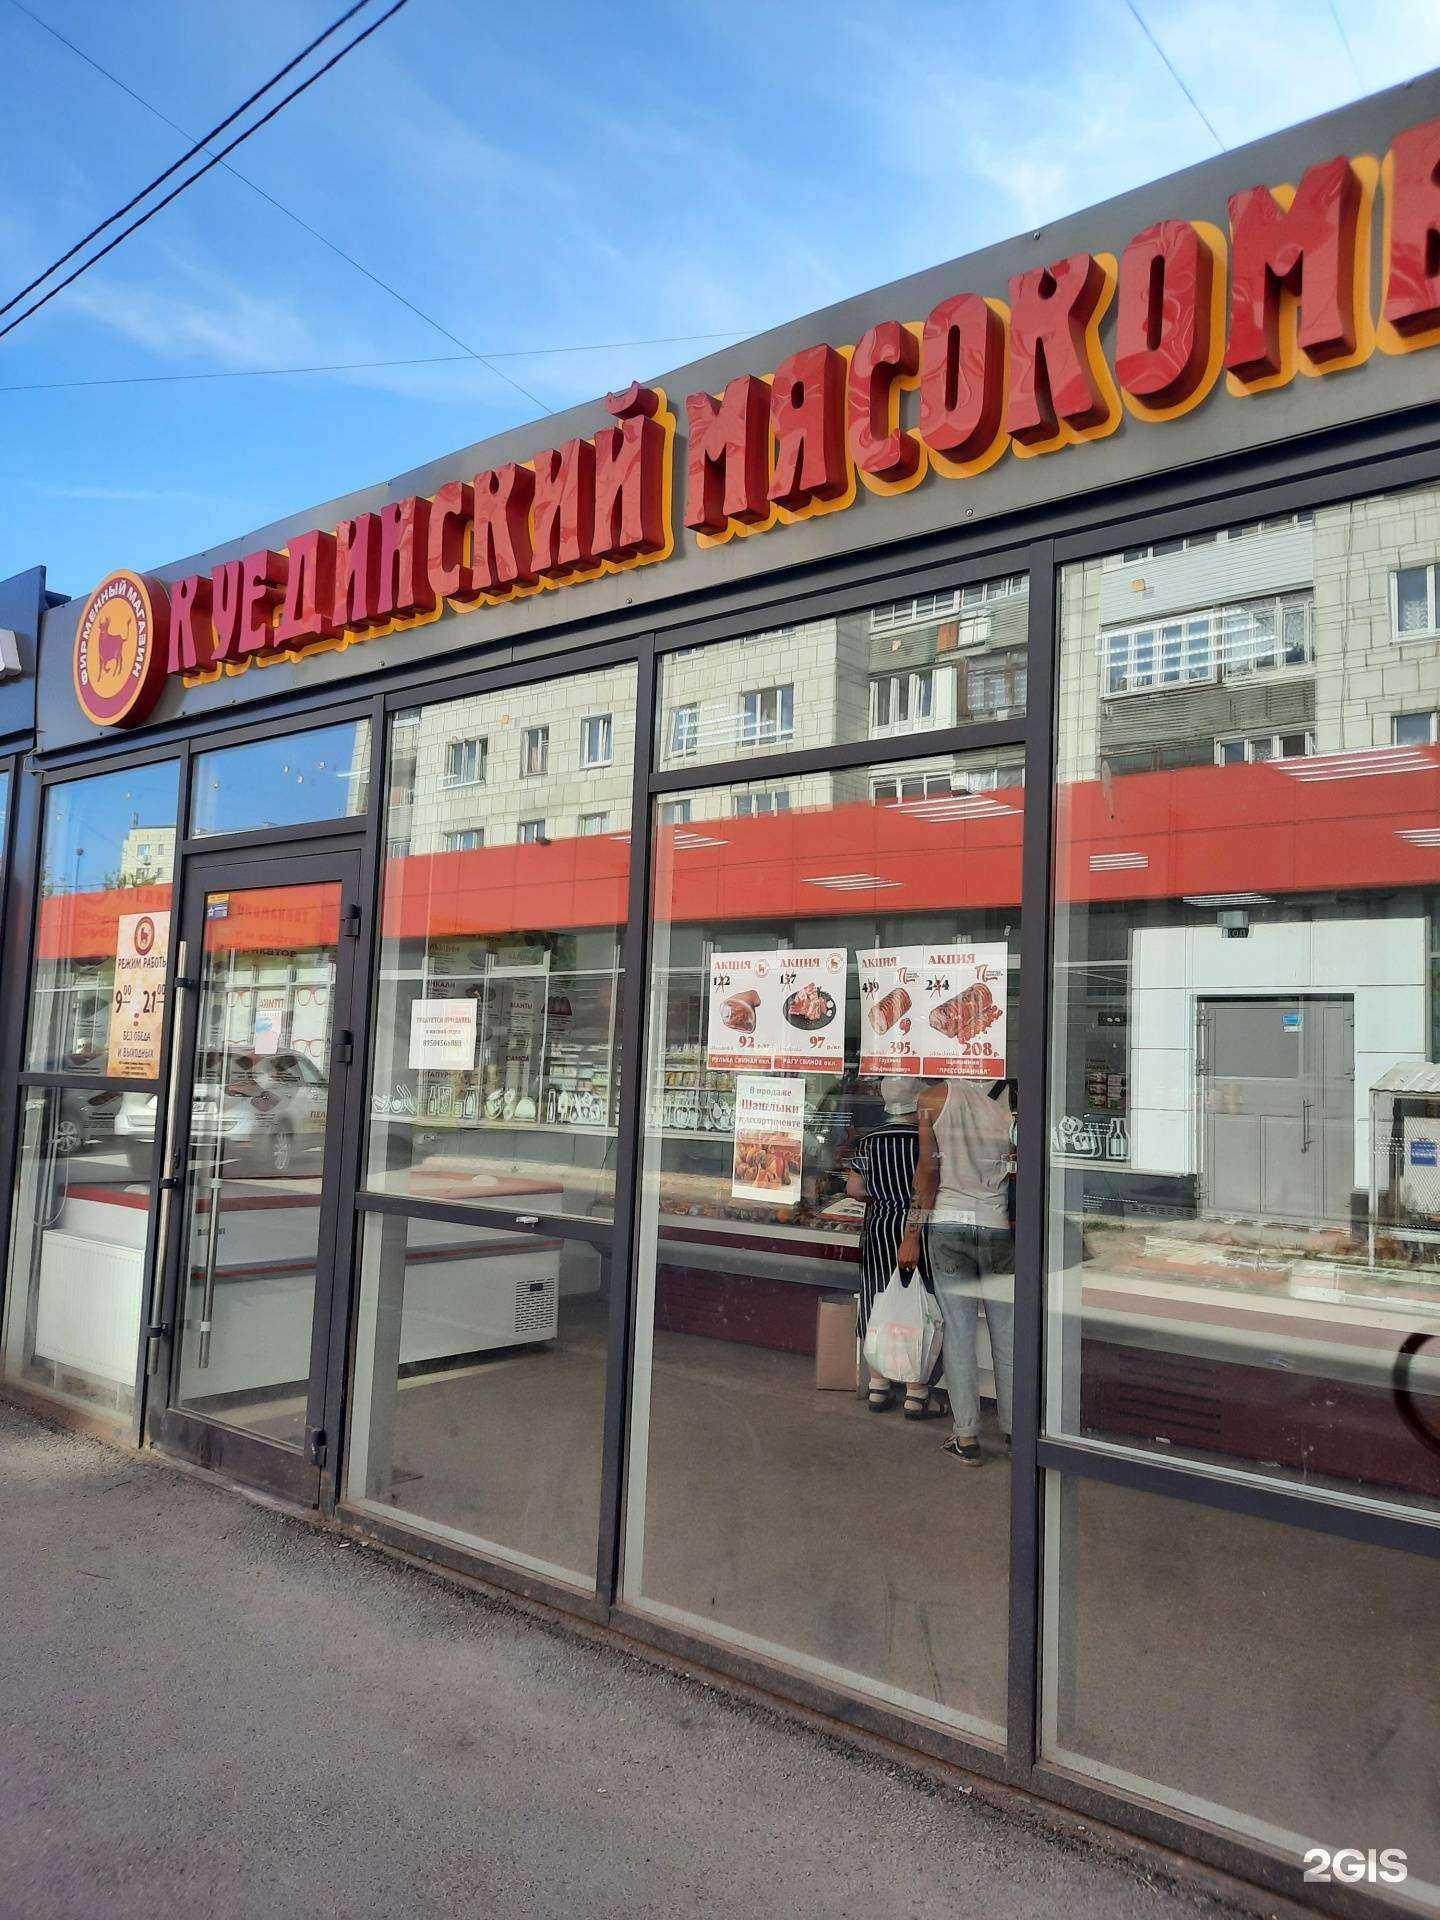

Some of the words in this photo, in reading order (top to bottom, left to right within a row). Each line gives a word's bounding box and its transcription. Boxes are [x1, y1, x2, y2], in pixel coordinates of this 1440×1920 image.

[167, 381, 667, 679] КУЕДИНСКИЙ
[79, 581, 127, 685] ФИРМЕННЫЙ
[127, 586, 147, 678] МАГАЗИН
[117, 958, 141, 970] РЕЖИМ
[714, 960, 752, 970] АКЦИЯ
[781, 958, 820, 969] АКЦИЯ
[862, 956, 897, 968] АКЦИЯ
[928, 953, 976, 965] АКЦИЯ
[122, 1031, 133, 1041] БЕЗ
[134, 1031, 151, 1041] ОБЕДА
[738, 1035, 755, 1048] 92
[809, 1036, 826, 1049] 97
[889, 1041, 911, 1054] 395
[962, 1042, 992, 1056] 208
[783, 1057, 799, 1065] РАГУ
[741, 1099, 799, 1113] Шашлыки
